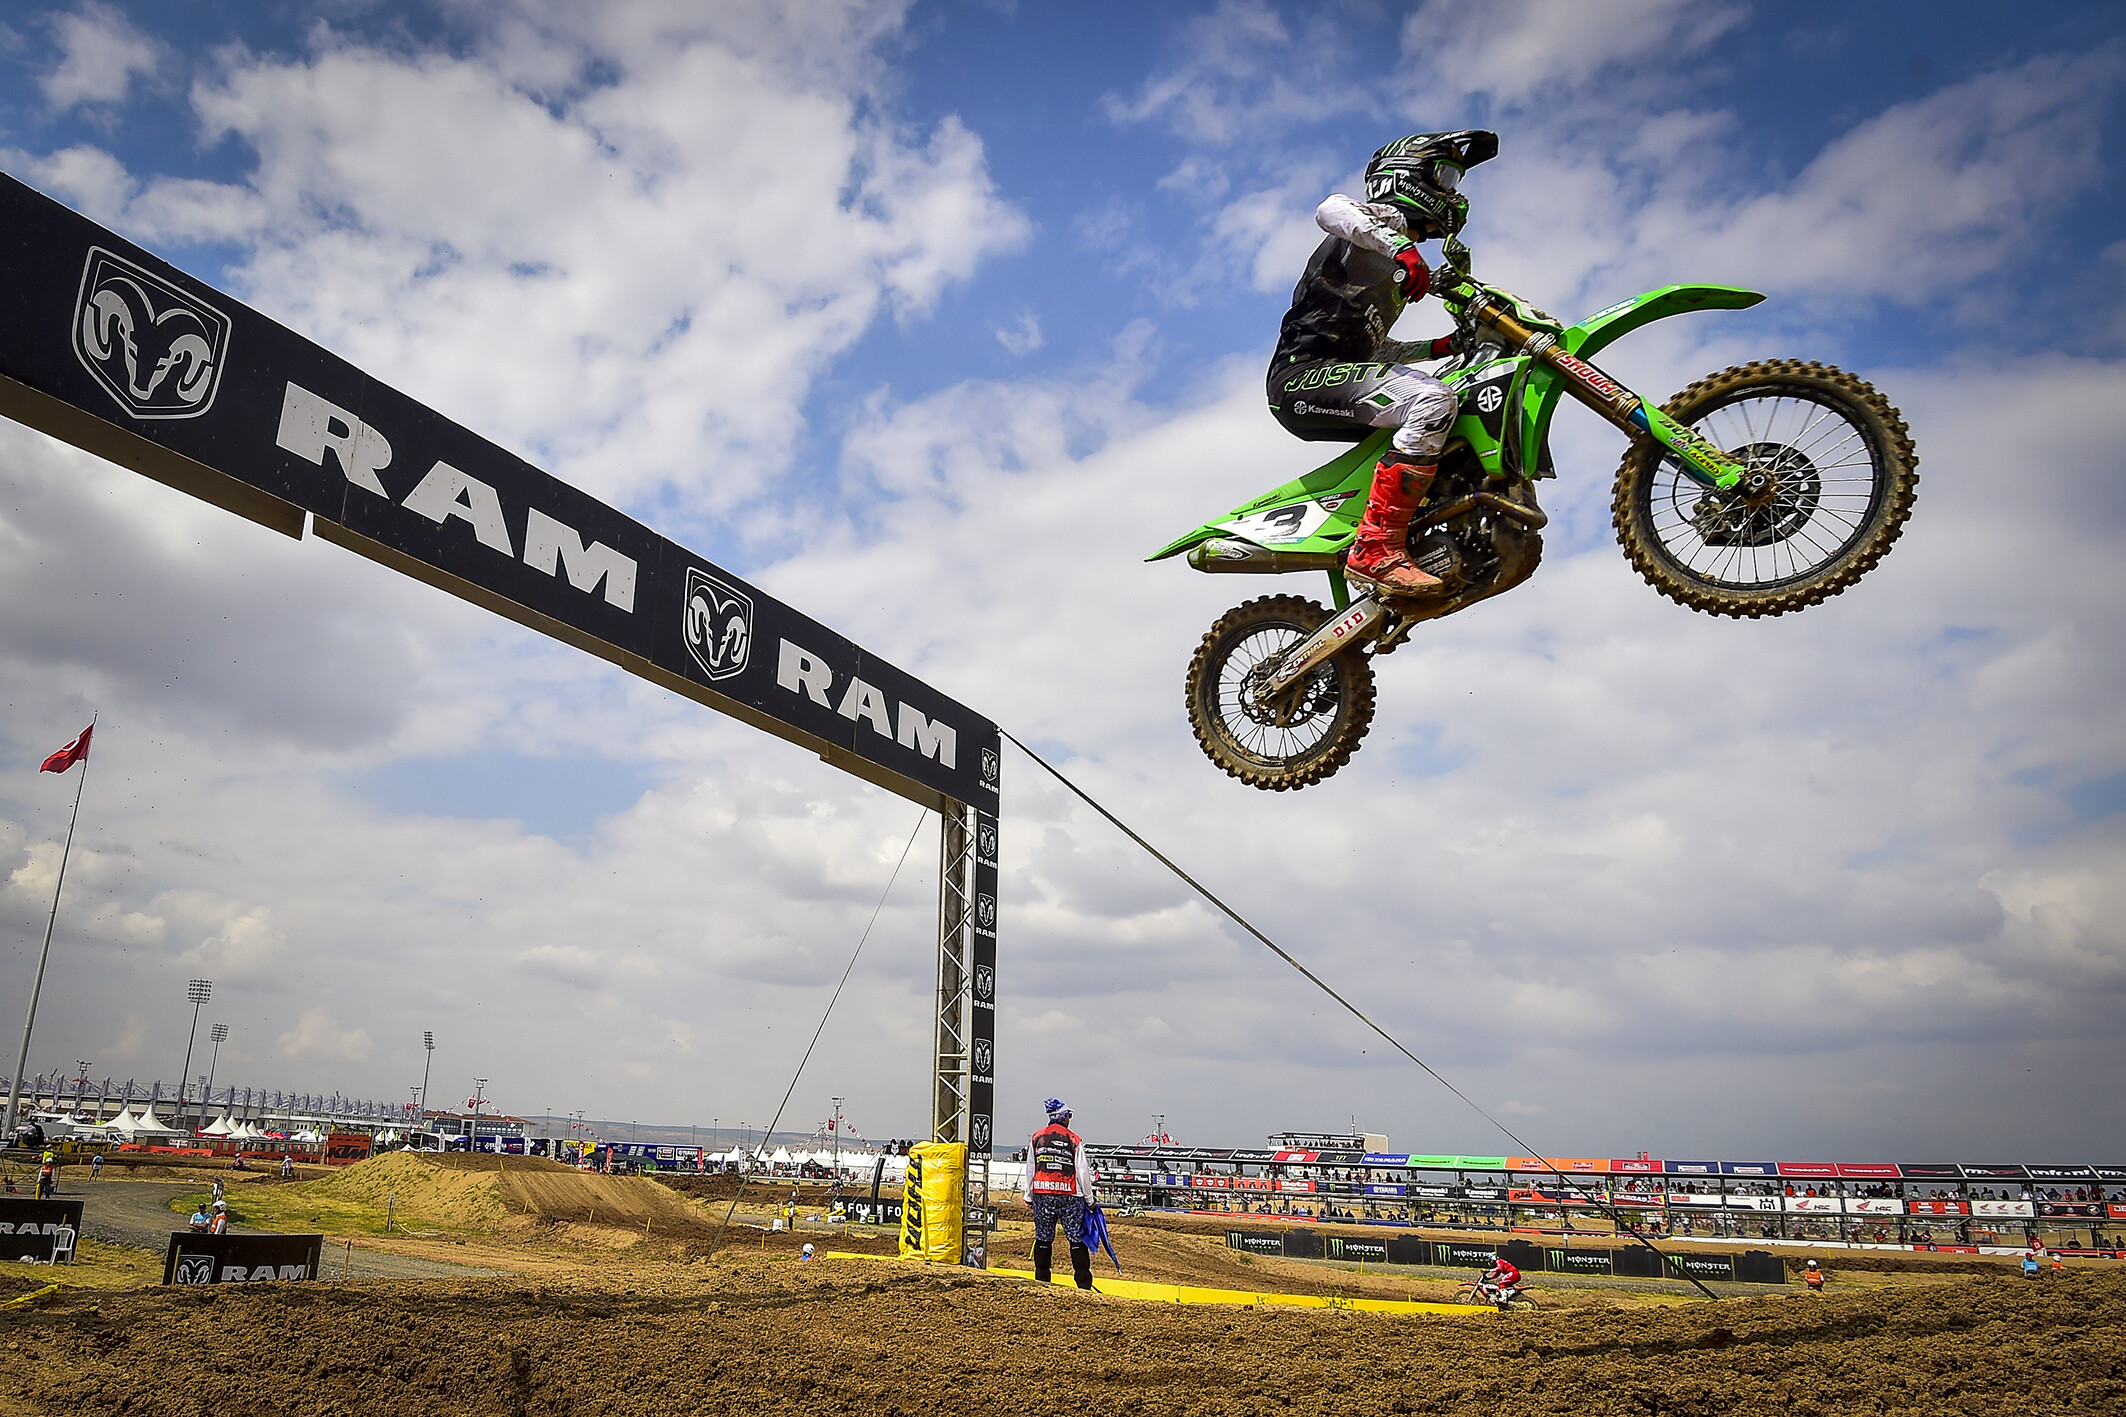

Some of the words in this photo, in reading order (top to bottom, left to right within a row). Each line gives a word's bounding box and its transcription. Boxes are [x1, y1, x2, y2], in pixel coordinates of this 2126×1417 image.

[1398, 179, 1436, 206] MONSTER
[1556, 354, 1617, 395] SHOWA
[1308, 405, 1354, 418] Kawasaki
[1689, 452, 1720, 475] ACERBIS
[276, 381, 637, 614] RAM
[1262, 504, 1308, 537] 3
[777, 637, 957, 770] RAM
[979, 779, 999, 794] RAM
[977, 856, 997, 869] RAM
[975, 926, 996, 939] RAM
[973, 1000, 994, 1011] RAM
[972, 1074, 993, 1084] RAM
[328, 1145, 368, 1159] KTM
[970, 1151, 992, 1160] RAM
[1033, 1181, 1072, 1191] MARSHALL
[1416, 1186, 1448, 1194] Kawasaki
[888, 1206, 902, 1217] FO
[1244, 1238, 1281, 1247] MONSTER
[1345, 1244, 1385, 1253] MONSTER
[1567, 1256, 1611, 1265] MONSTER
[1686, 1261, 1731, 1270] MONSTER
[221, 1264, 311, 1281] RAM
